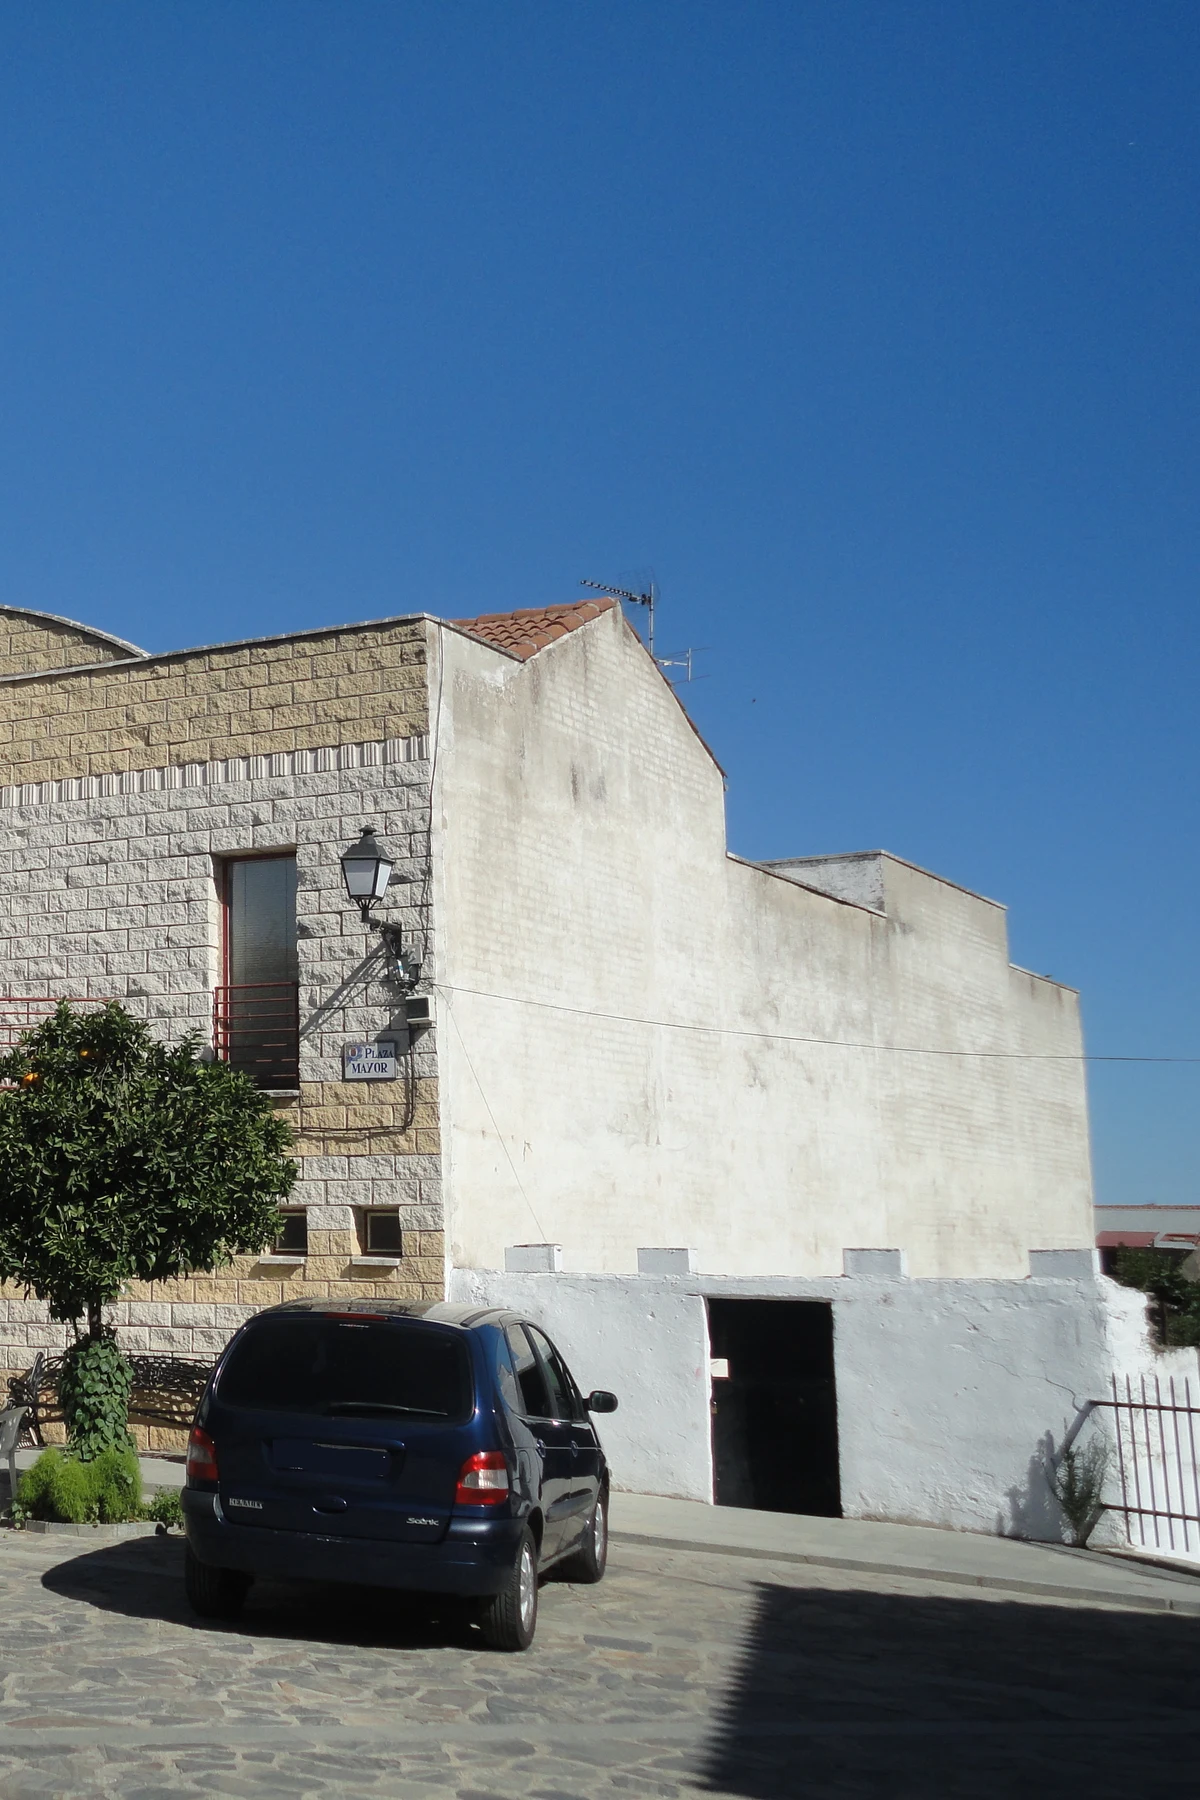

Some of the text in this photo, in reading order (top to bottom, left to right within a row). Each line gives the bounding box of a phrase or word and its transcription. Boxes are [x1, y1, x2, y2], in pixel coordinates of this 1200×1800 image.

[365, 1047, 394, 1059] PLAZA
[351, 1062, 388, 1074] MAYOR
[229, 1497, 263, 1510] RENAULT
